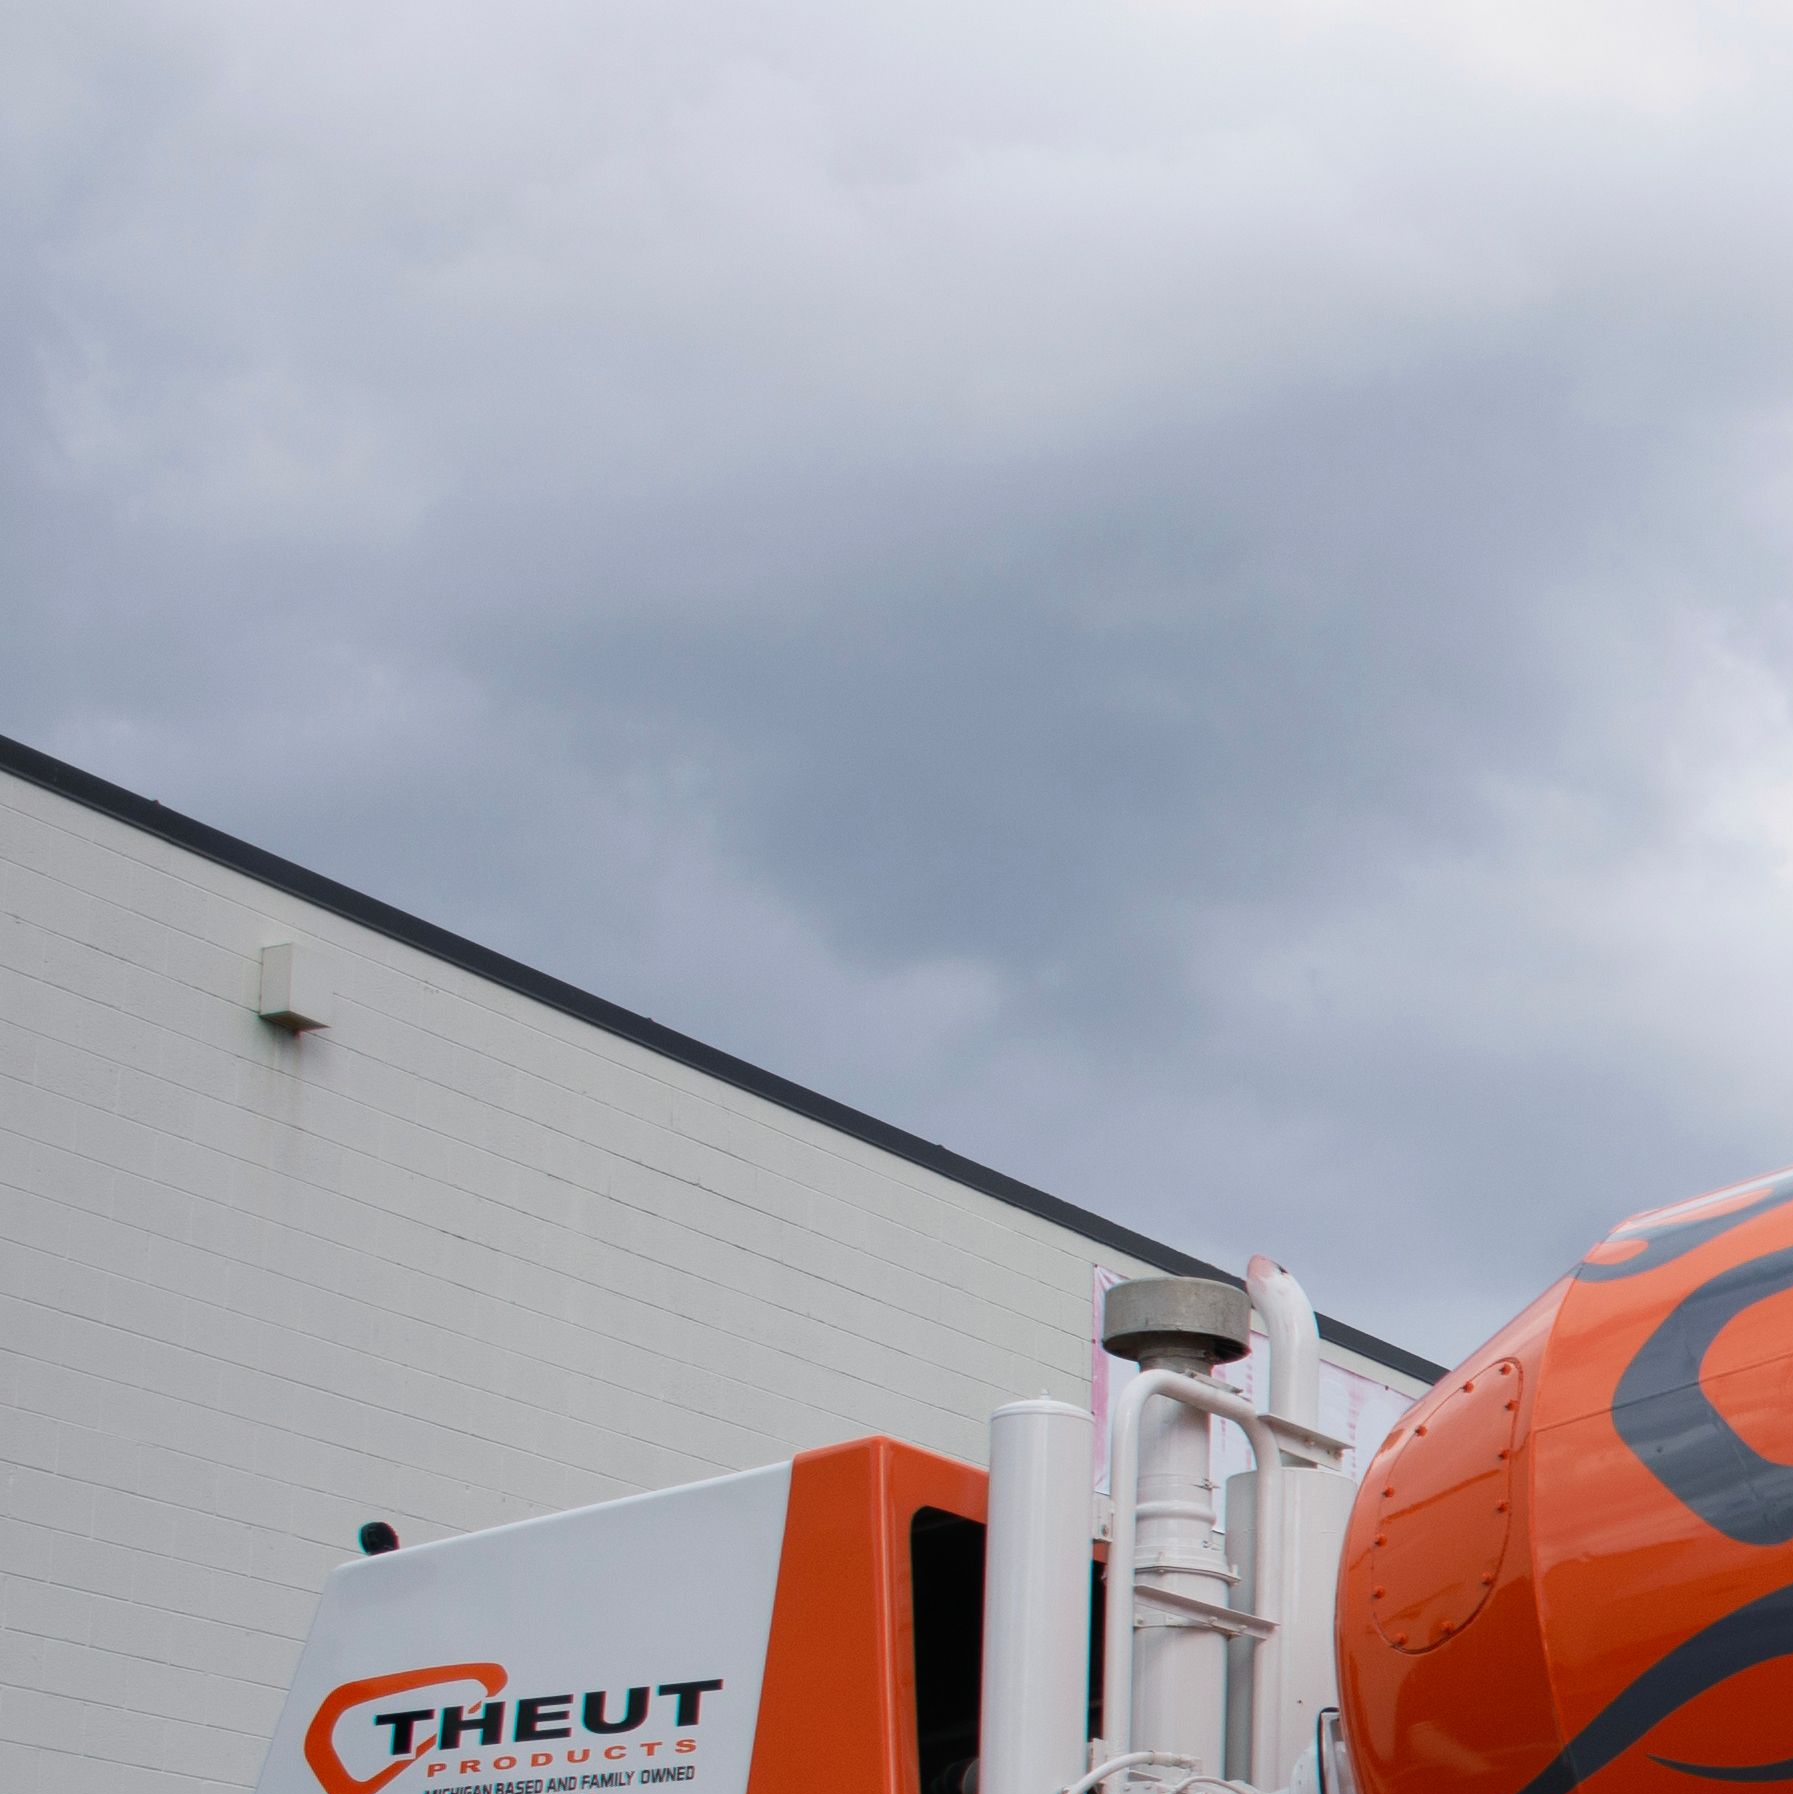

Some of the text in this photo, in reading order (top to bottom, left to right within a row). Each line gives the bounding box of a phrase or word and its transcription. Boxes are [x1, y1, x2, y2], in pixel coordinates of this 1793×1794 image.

[373, 1678, 724, 1756] THEUT
[427, 1738, 698, 1778] PRODUCTS
[546, 1776, 578, 1794] AND
[581, 1770, 636, 1790] FAMILY
[640, 1765, 695, 1785] OWNED
